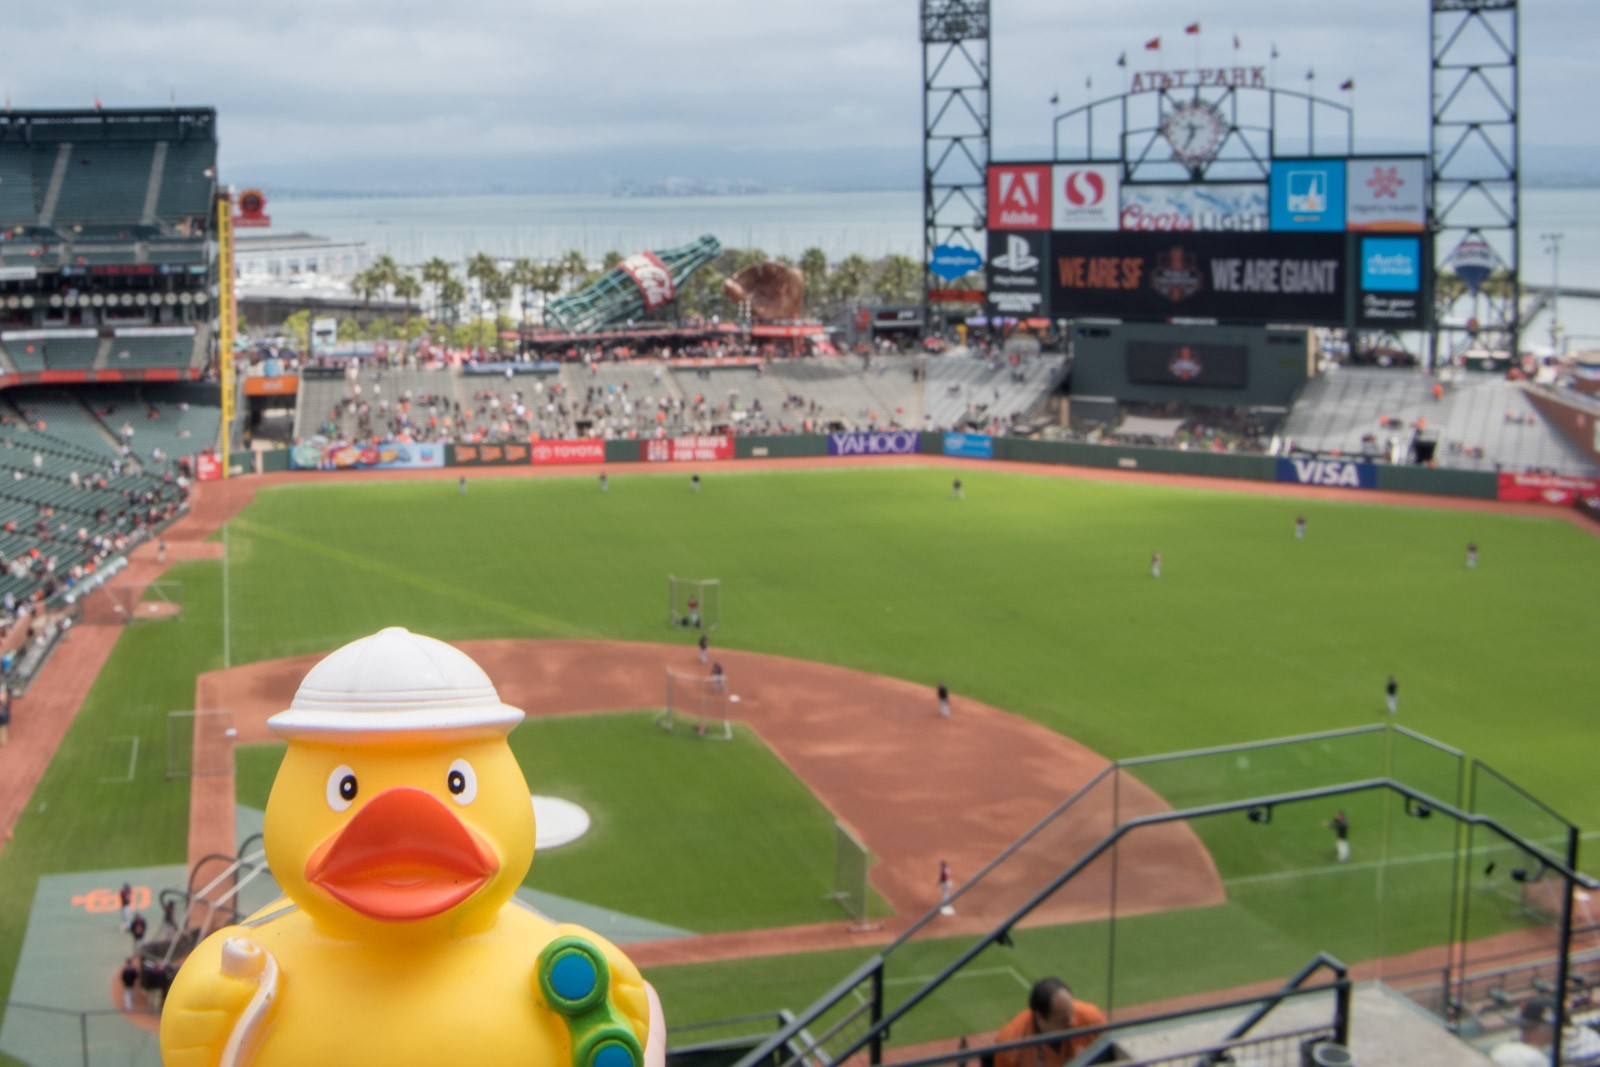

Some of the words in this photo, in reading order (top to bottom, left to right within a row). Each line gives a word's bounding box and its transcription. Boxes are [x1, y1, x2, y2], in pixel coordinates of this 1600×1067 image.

[1197, 66, 1265, 88] PARK
[1199, 212, 1268, 231] LIGHT
[1058, 256, 1085, 288] WE
[1087, 256, 1120, 288] ARE
[1121, 256, 1144, 289] SF
[1211, 258, 1242, 291] WE
[1243, 258, 1280, 292] ARE
[1281, 258, 1339, 293] GIANT
[554, 445, 603, 458] TOYOTA
[831, 432, 918, 455] YAHOO!
[1294, 460, 1360, 487] VISA
